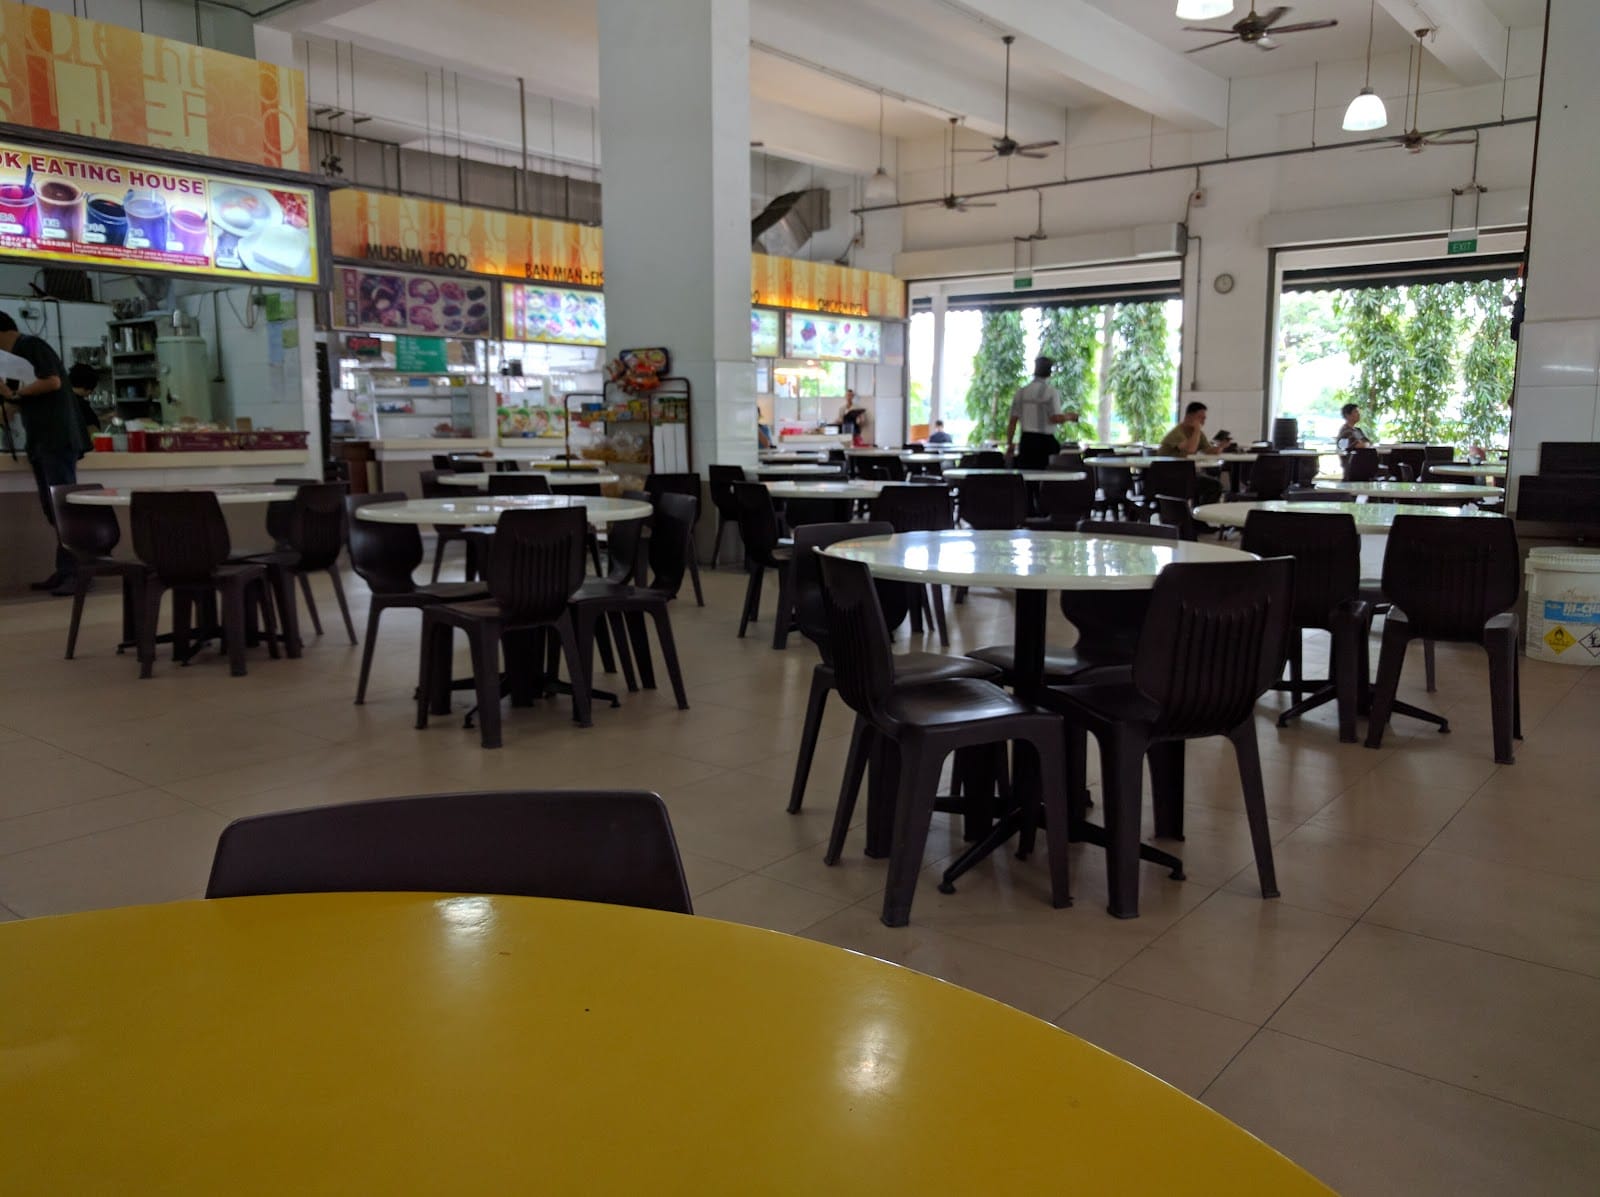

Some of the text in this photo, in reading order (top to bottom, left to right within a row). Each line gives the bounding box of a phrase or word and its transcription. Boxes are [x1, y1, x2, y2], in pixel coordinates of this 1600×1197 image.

[0, 152, 205, 195] K EATING HOUSE
[366, 243, 468, 271] MUSLIM FOOD
[1453, 241, 1472, 252] EXIT
[525, 263, 550, 280] BAN
